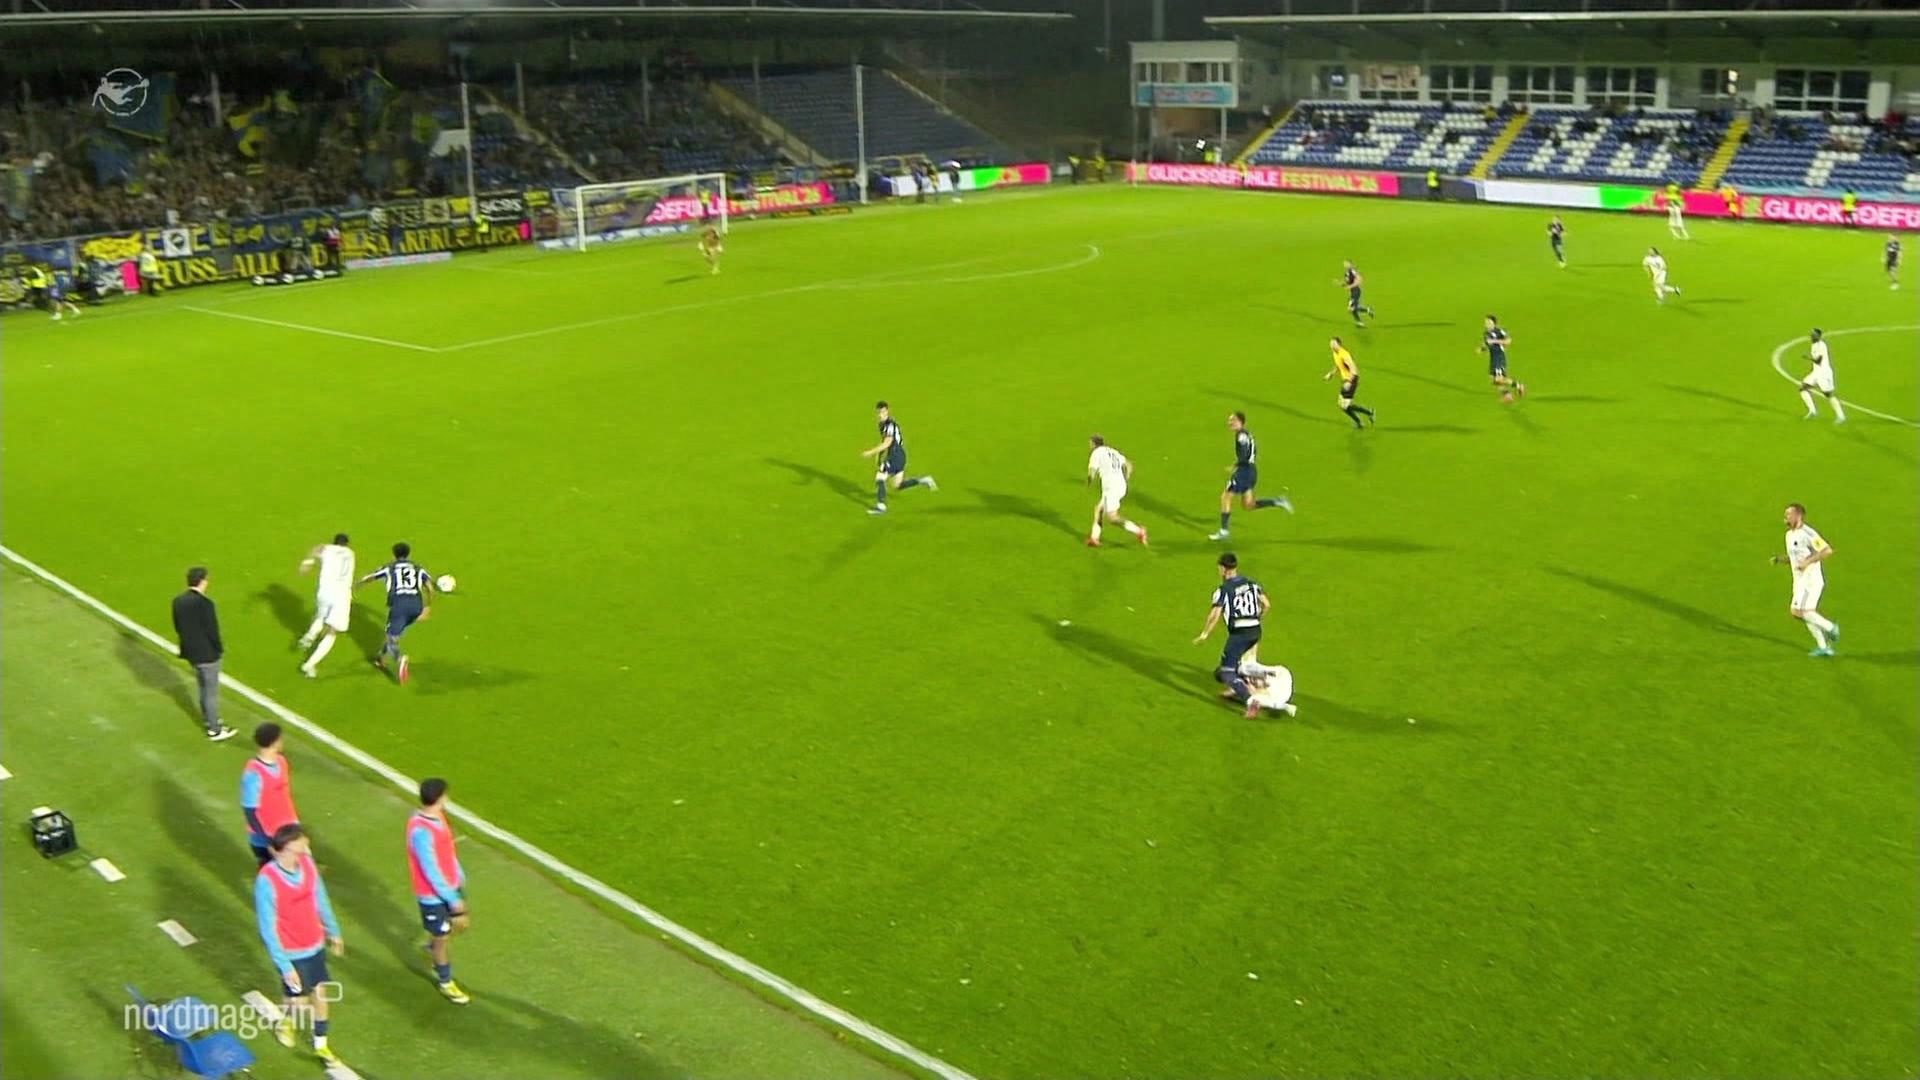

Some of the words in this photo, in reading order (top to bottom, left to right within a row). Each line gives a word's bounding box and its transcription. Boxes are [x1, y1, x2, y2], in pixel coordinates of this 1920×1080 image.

[1282, 170, 1360, 191] FESTIVAL
[395, 567, 417, 589] 13
[1232, 590, 1256, 618] 38
